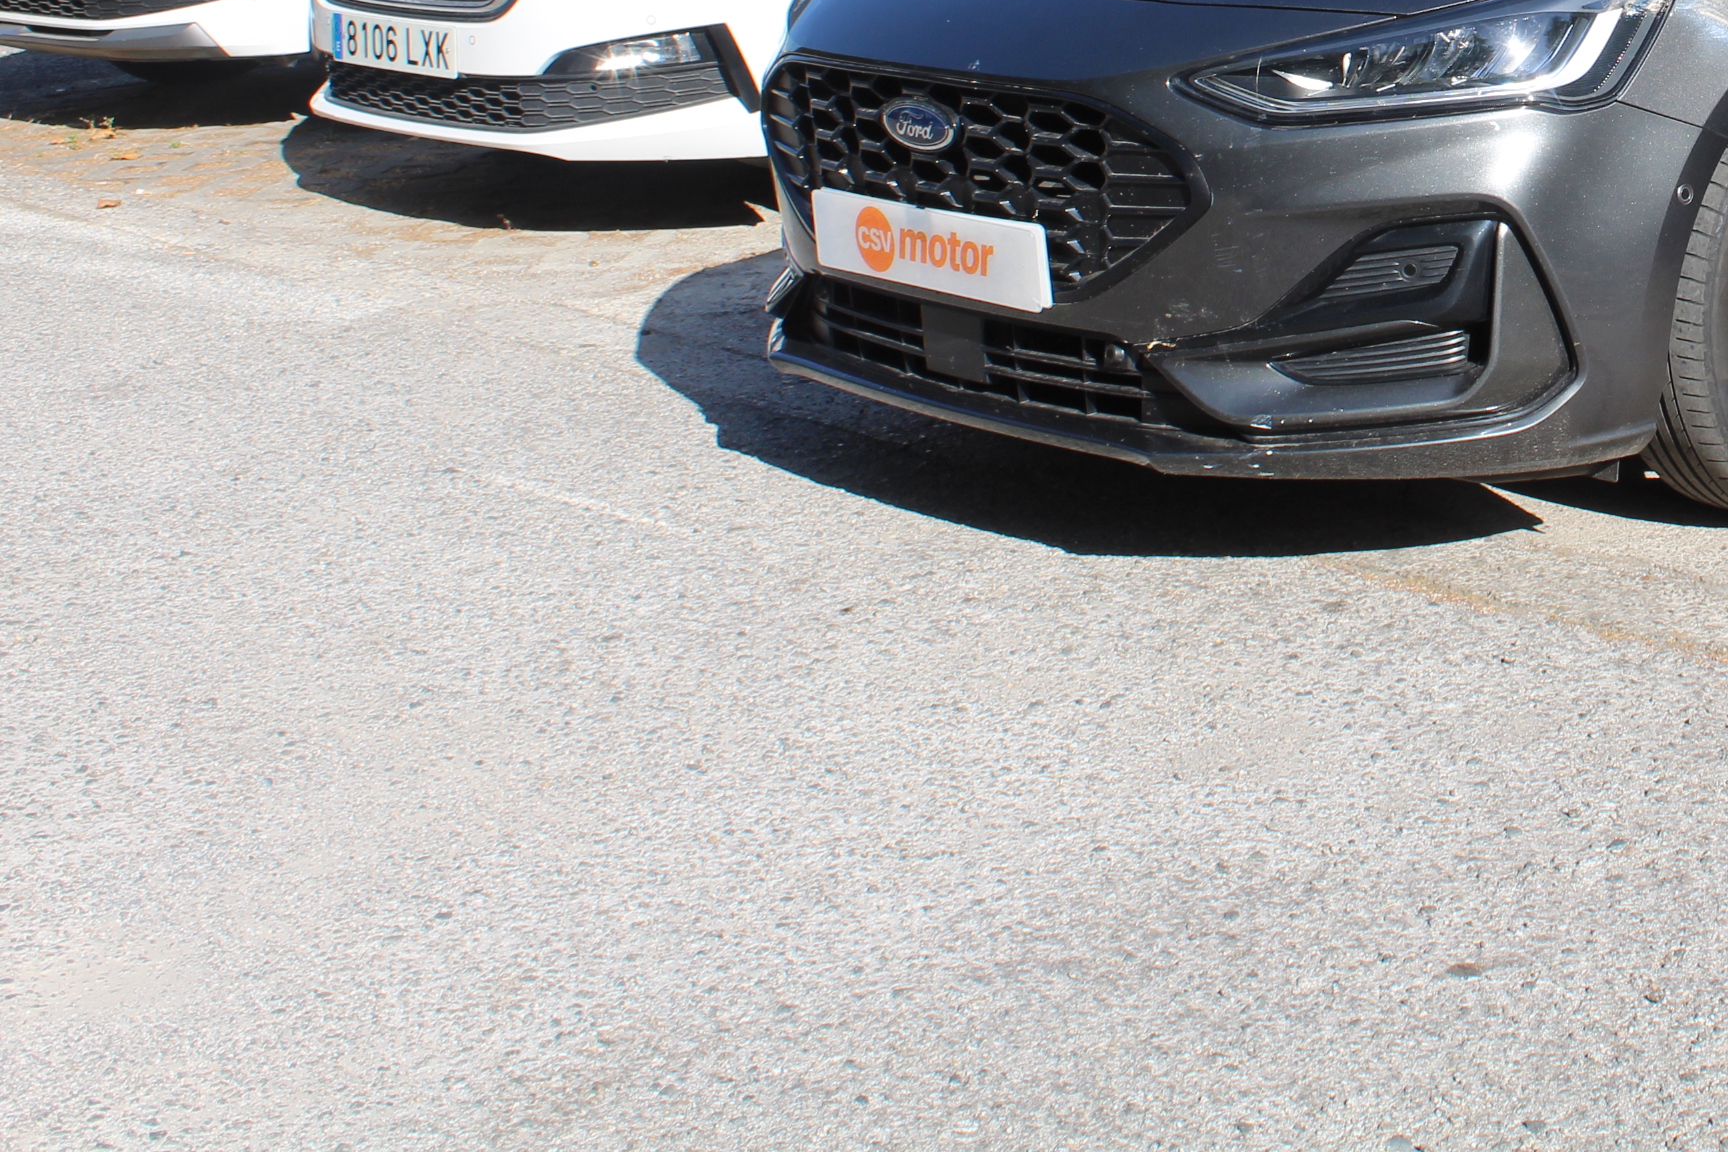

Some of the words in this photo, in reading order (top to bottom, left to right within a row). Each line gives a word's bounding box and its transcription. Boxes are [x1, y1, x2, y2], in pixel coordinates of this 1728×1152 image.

[347, 20, 398, 62] 8106
[406, 28, 450, 70] LXK
[896, 110, 934, 140] Ford
[857, 225, 893, 253] CSV
[899, 227, 995, 277] motor
